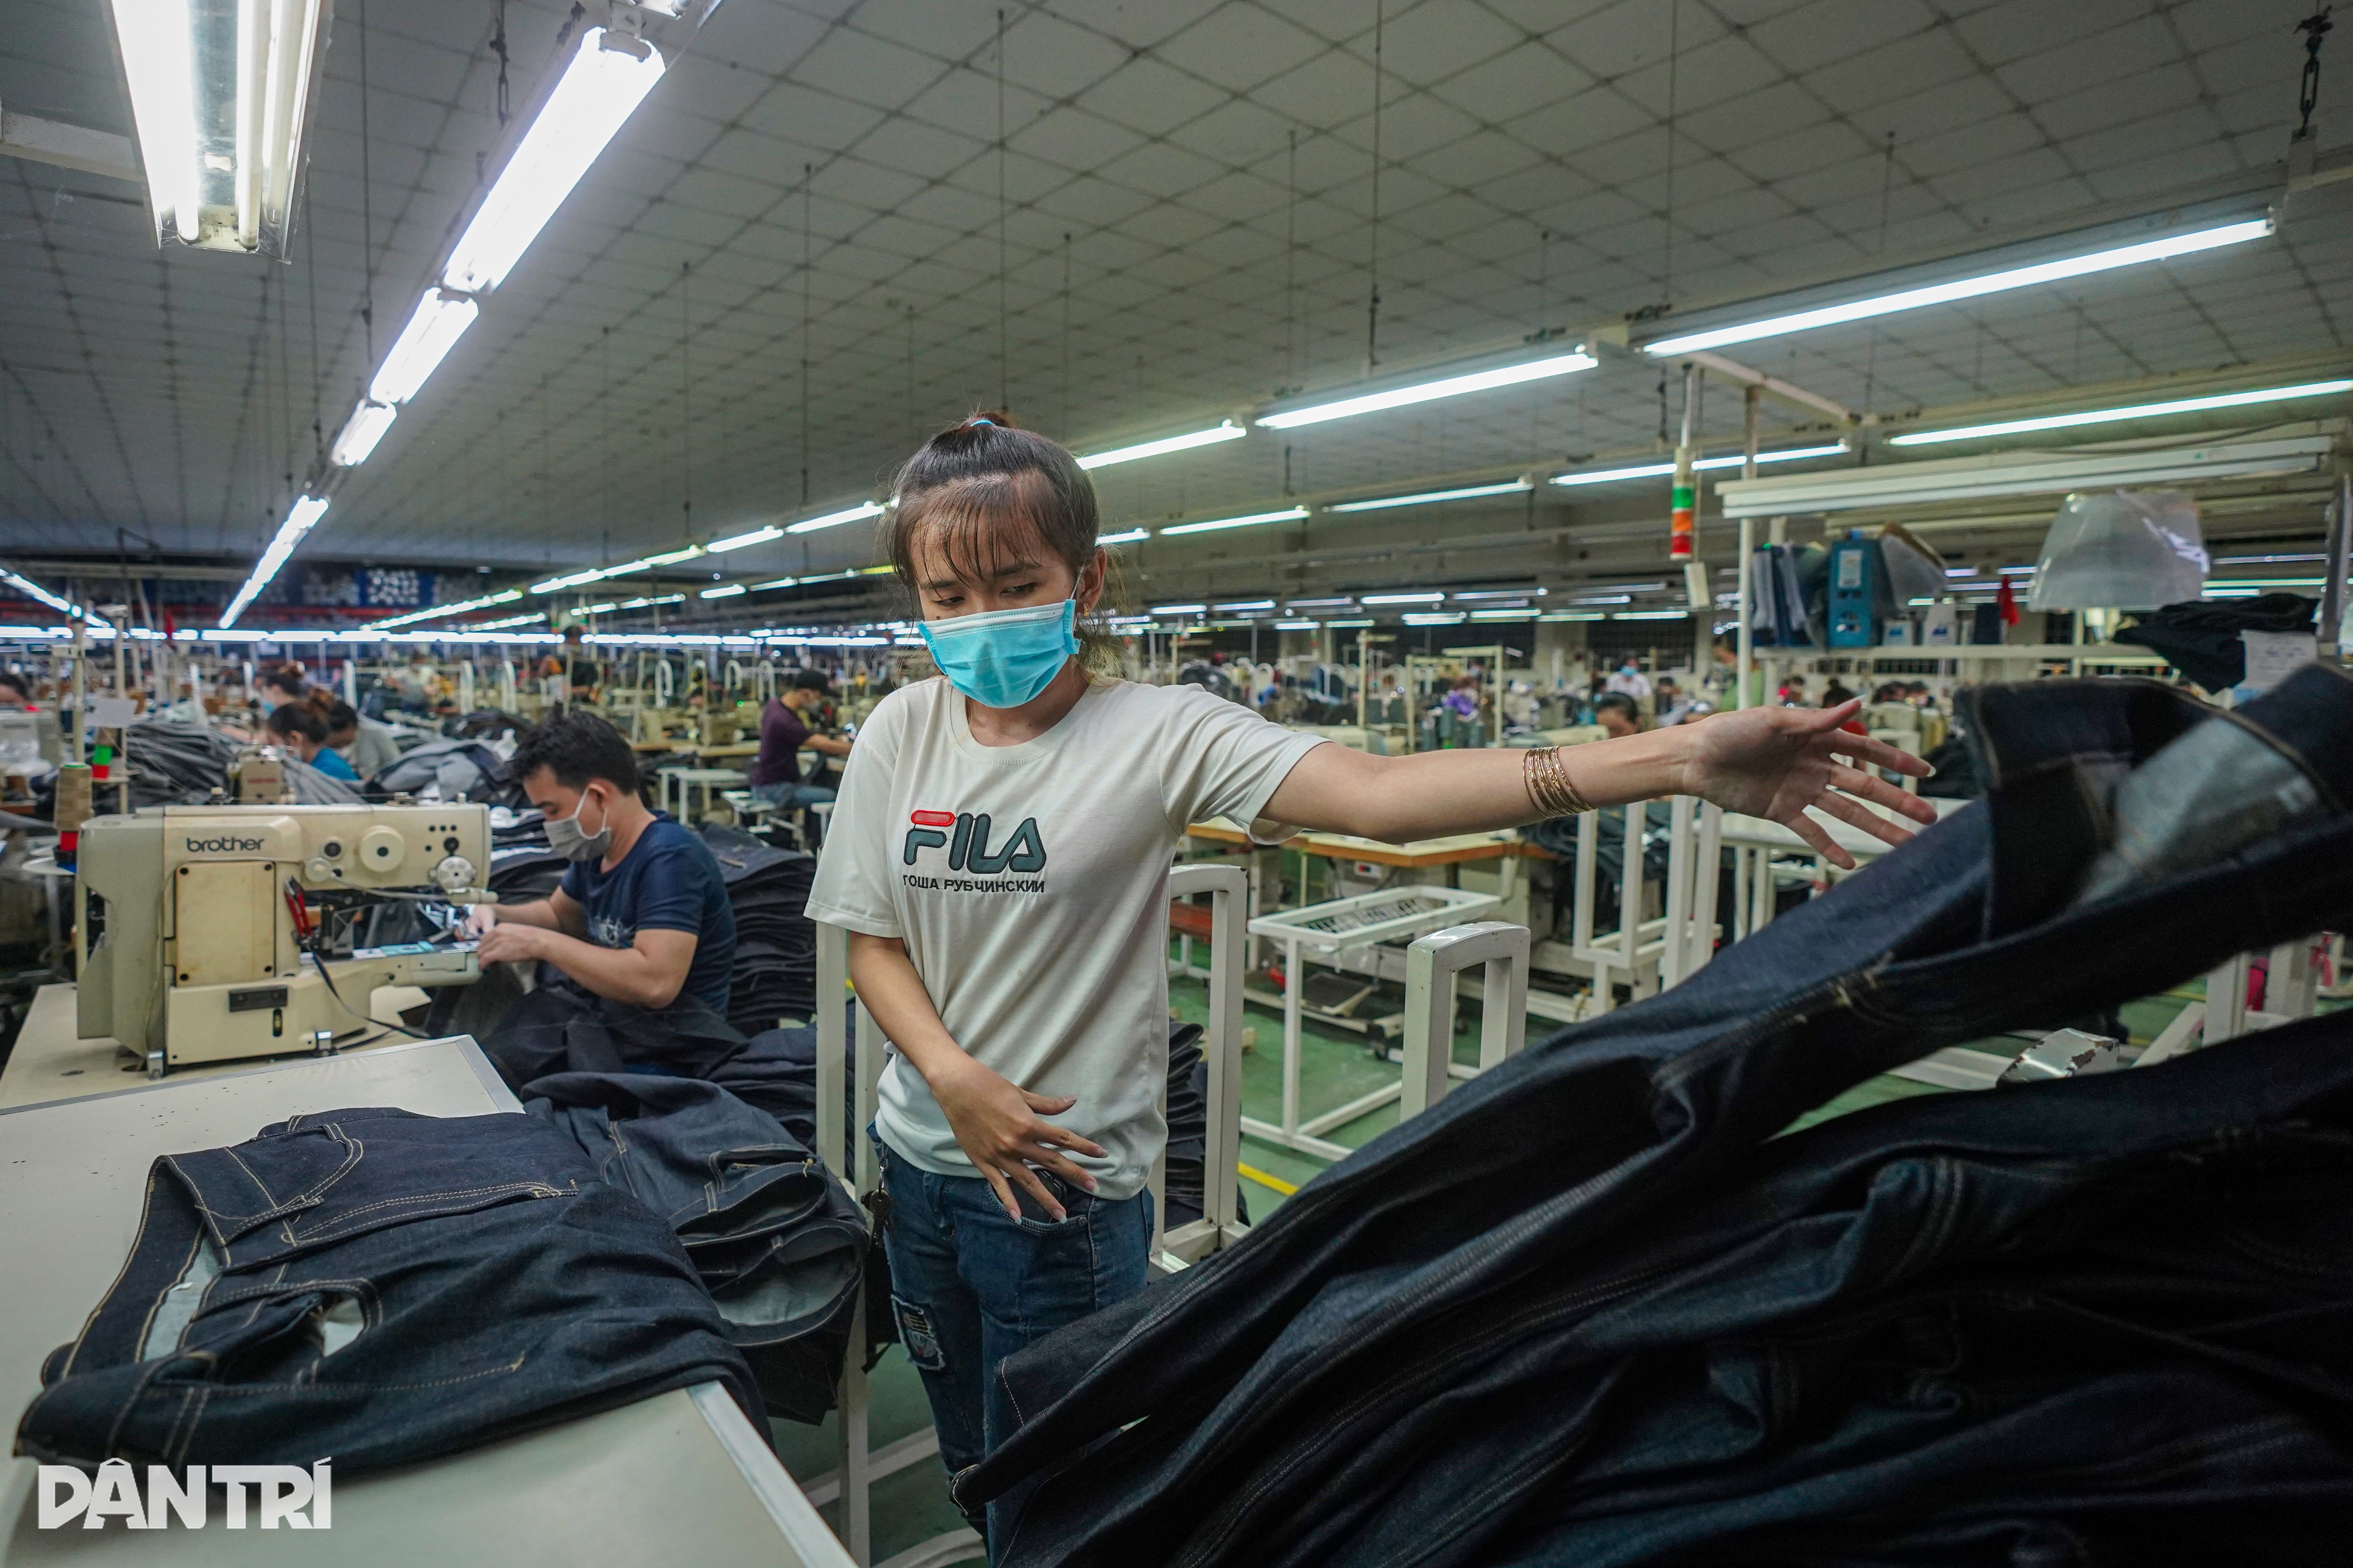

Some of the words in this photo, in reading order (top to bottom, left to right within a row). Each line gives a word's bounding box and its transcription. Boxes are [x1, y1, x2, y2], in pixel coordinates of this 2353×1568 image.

[187, 837, 265, 852] brother
[904, 810, 1046, 873] FILA
[903, 875, 939, 889] ГОША
